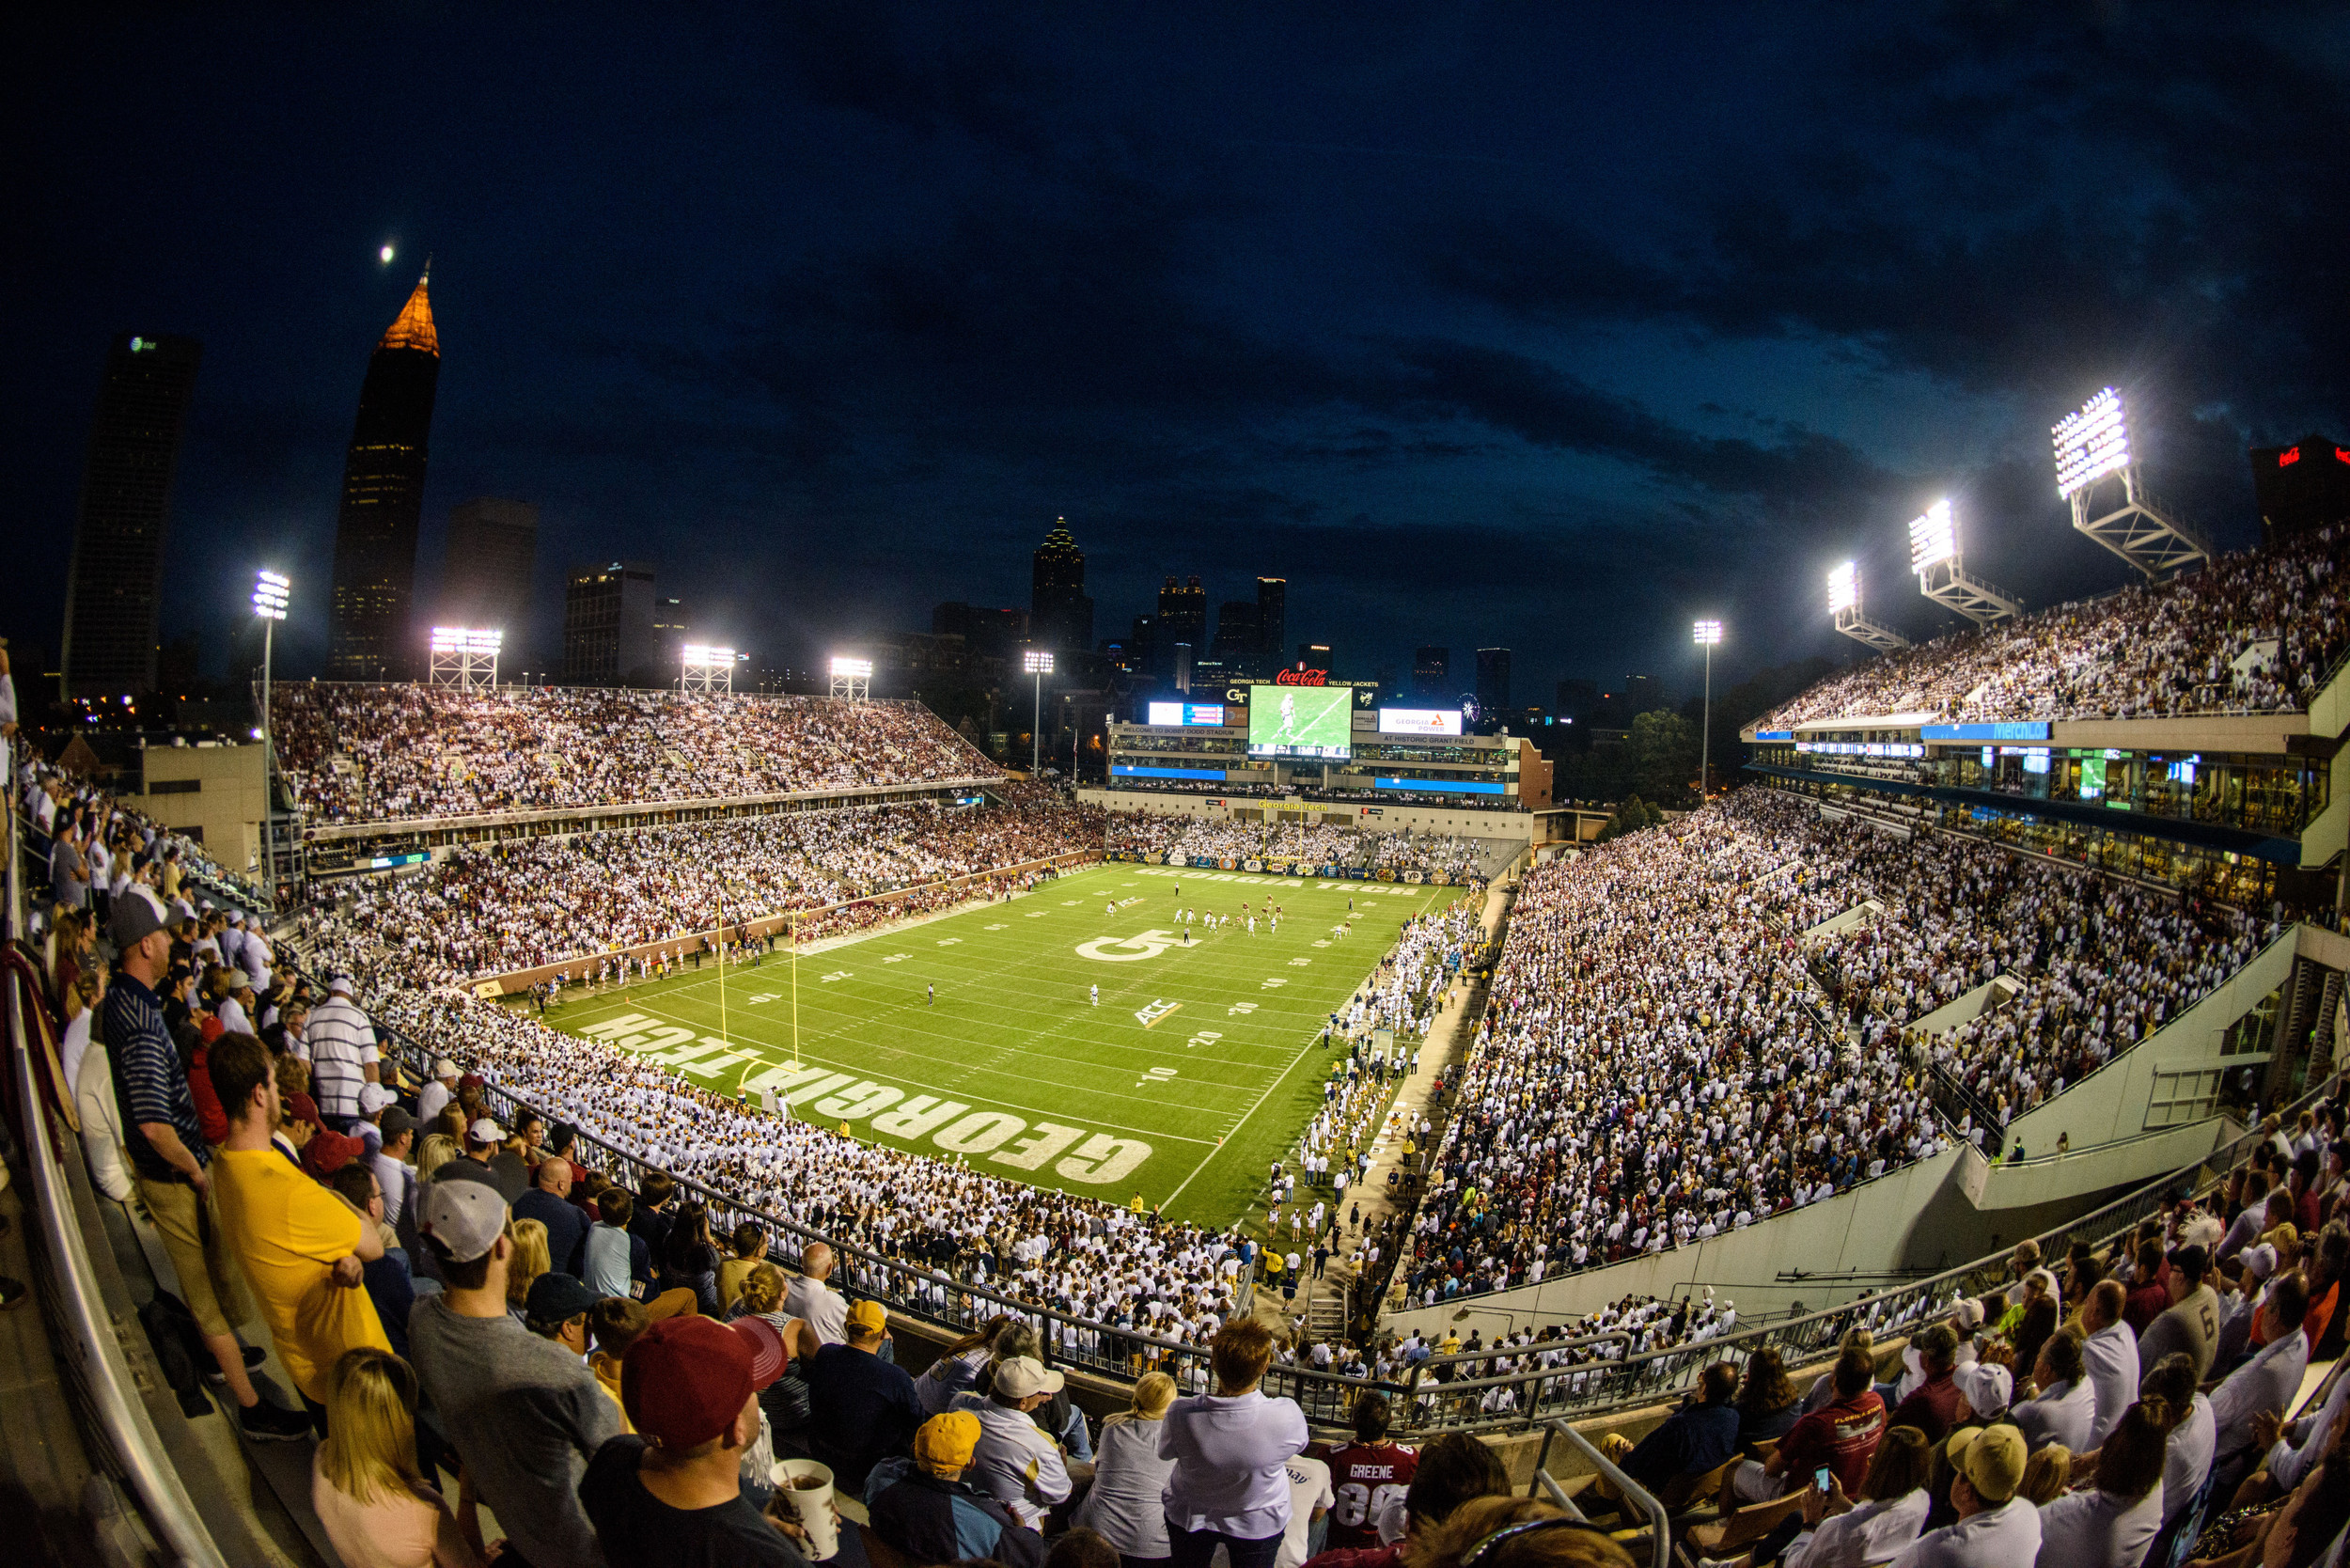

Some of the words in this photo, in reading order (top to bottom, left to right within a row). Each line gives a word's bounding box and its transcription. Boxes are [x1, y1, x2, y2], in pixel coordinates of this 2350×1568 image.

[1277, 668, 1328, 686] Coca-Cola
[1258, 800, 1300, 811] Georgia
[1302, 802, 1328, 812] Tech
[1134, 868, 1304, 887] GEORGIA
[1316, 881, 1419, 896] TECH
[1074, 929, 1203, 962] GT
[1287, 957, 1312, 966] 50
[821, 970, 854, 981] 20
[1261, 978, 1288, 988] 40
[749, 993, 782, 1003] 10
[1134, 998, 1179, 1026] ACC
[1229, 1002, 1260, 1014] 30
[577, 1012, 764, 1079] TECH
[1188, 1030, 1223, 1046] 20
[1141, 1067, 1178, 1082] 10
[740, 1059, 1152, 1184] GEORGIA
[2200, 1304, 2215, 1341] 6
[1350, 1464, 1394, 1479] GREENE
